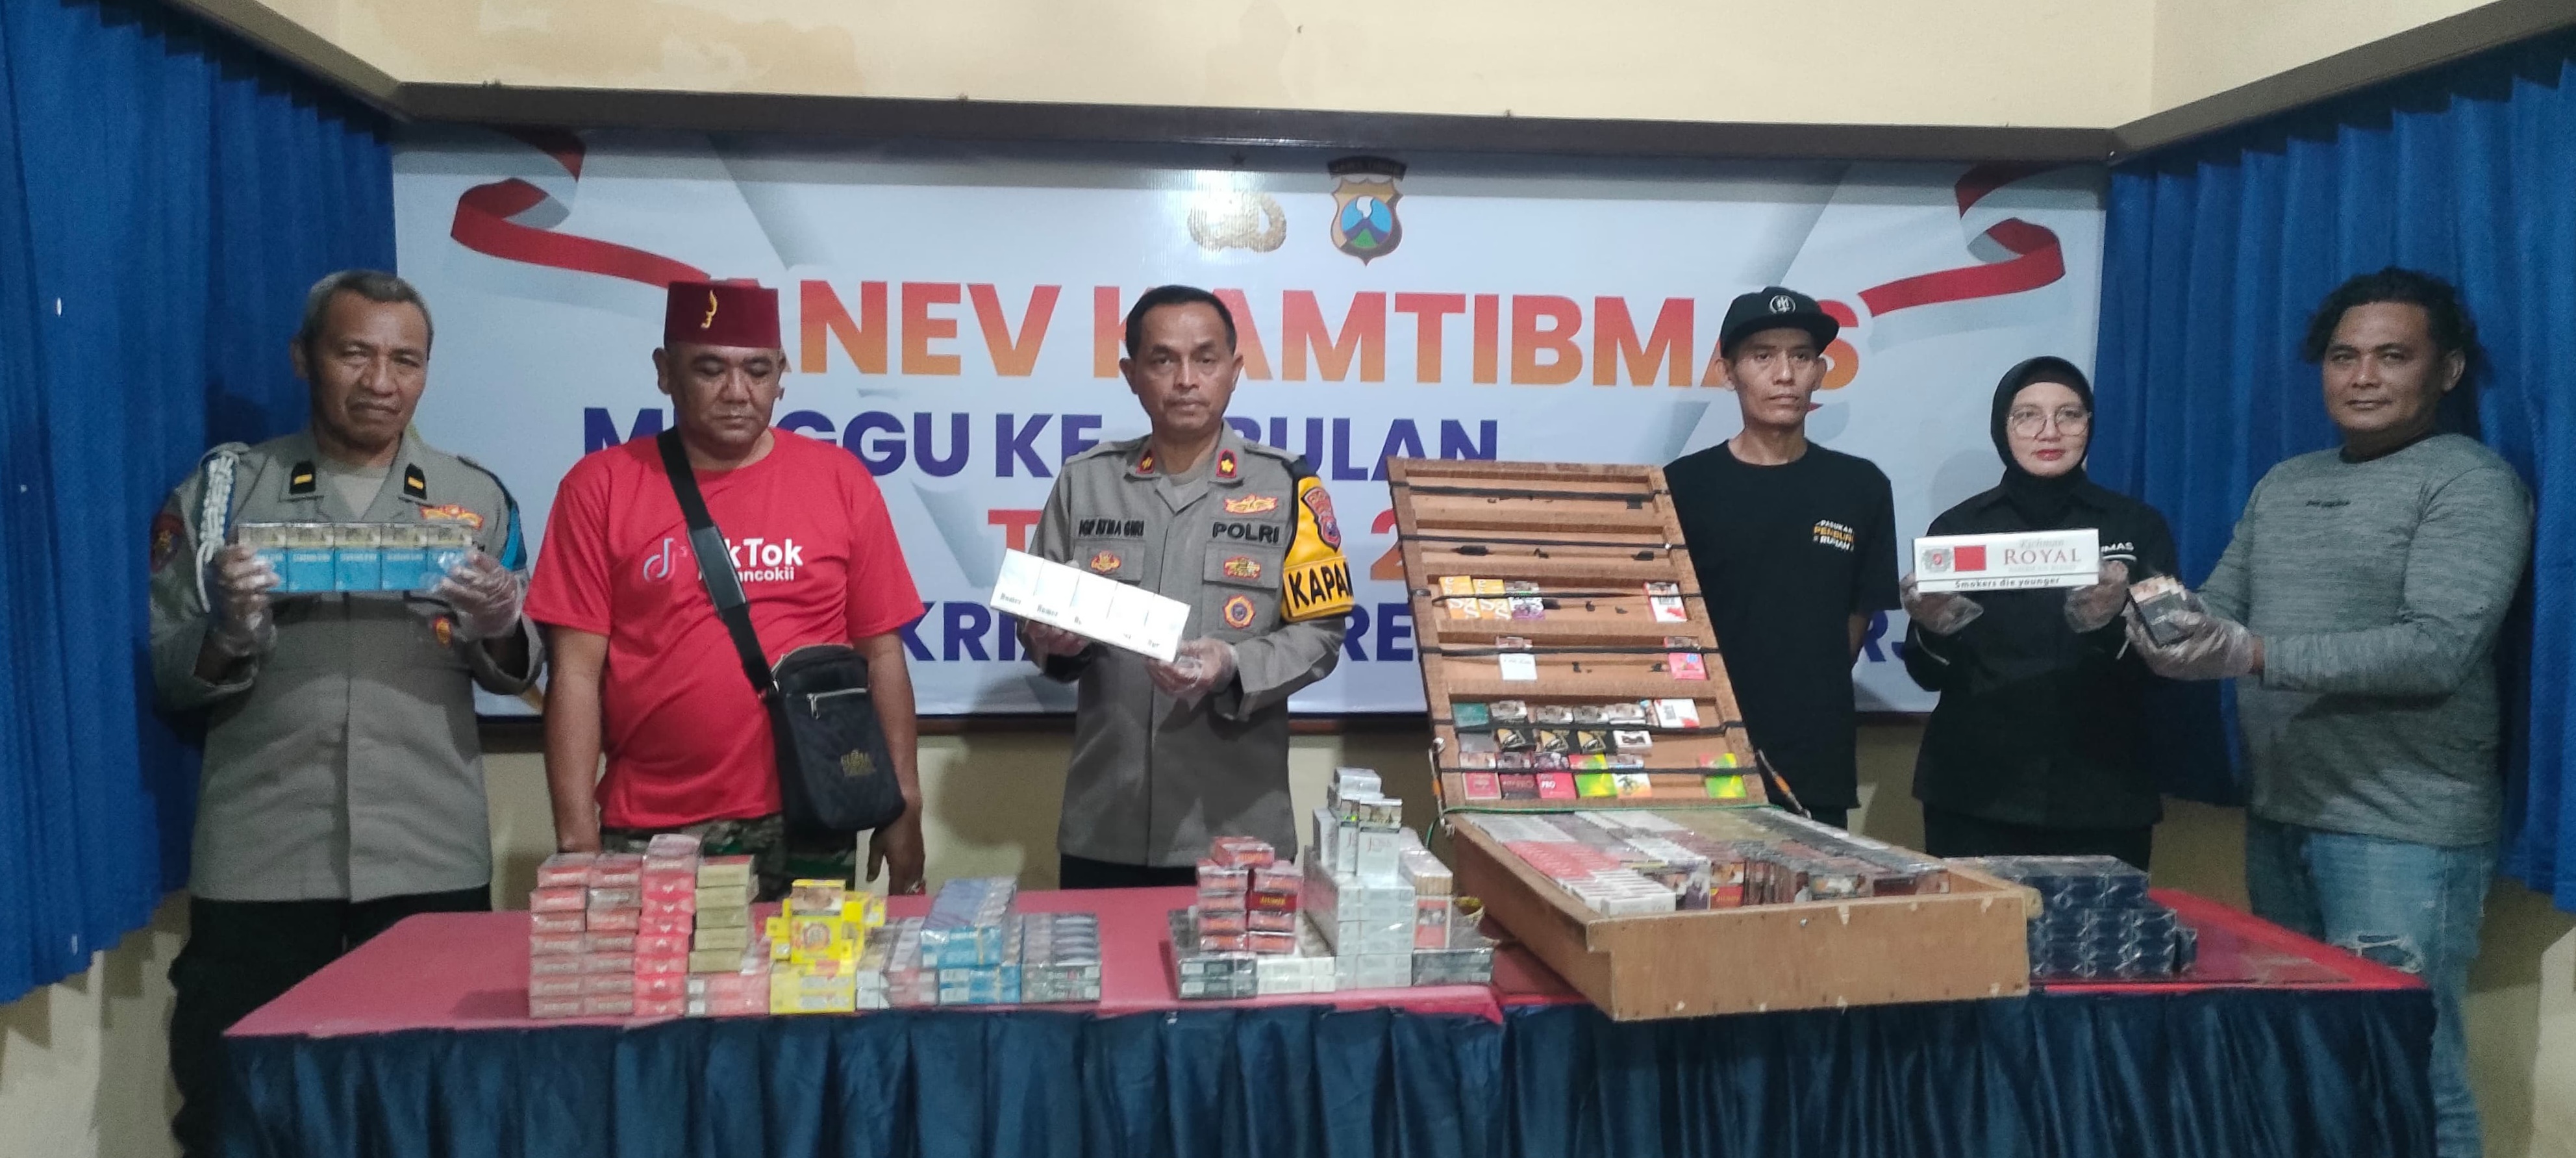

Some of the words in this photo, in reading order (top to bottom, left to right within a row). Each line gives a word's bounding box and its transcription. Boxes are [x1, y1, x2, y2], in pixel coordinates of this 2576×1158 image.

[722, 278, 1062, 377] NEV
[1212, 521, 1280, 544] POLRI
[723, 537, 804, 568] kTok
[2004, 548, 2082, 565] ROYAL
[1955, 580, 1996, 589] Smokers
[1999, 579, 2016, 587] die
[2019, 577, 2060, 588] younger
